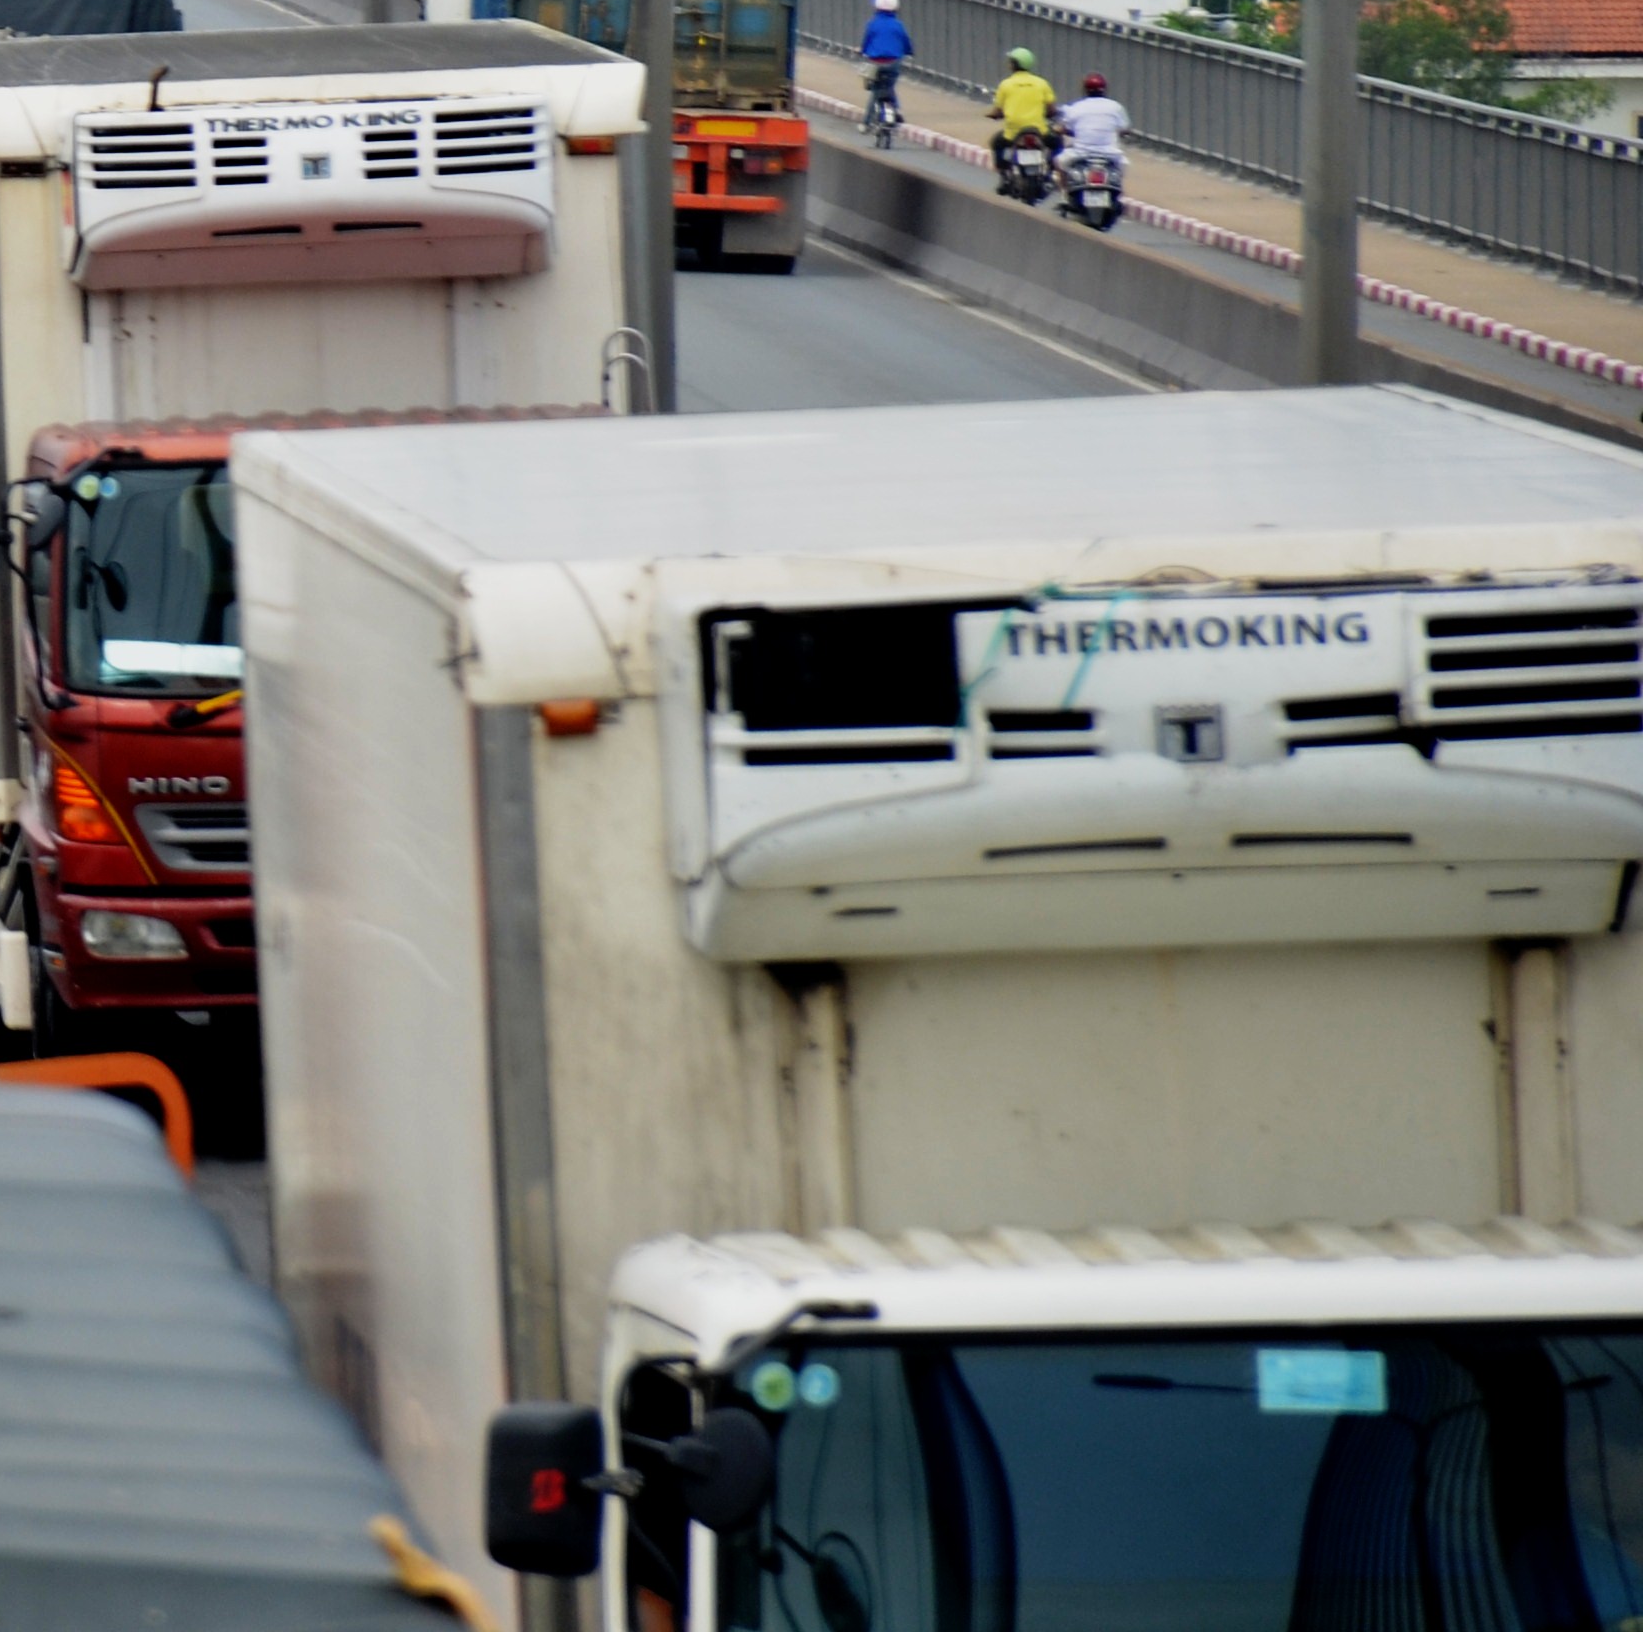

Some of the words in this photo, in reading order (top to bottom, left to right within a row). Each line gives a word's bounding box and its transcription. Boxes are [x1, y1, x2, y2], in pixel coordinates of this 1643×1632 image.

[205, 114, 333, 134] THERMO
[341, 108, 422, 129] KING
[1003, 611, 1373, 657] THERMOKING
[127, 775, 232, 795] HINO
